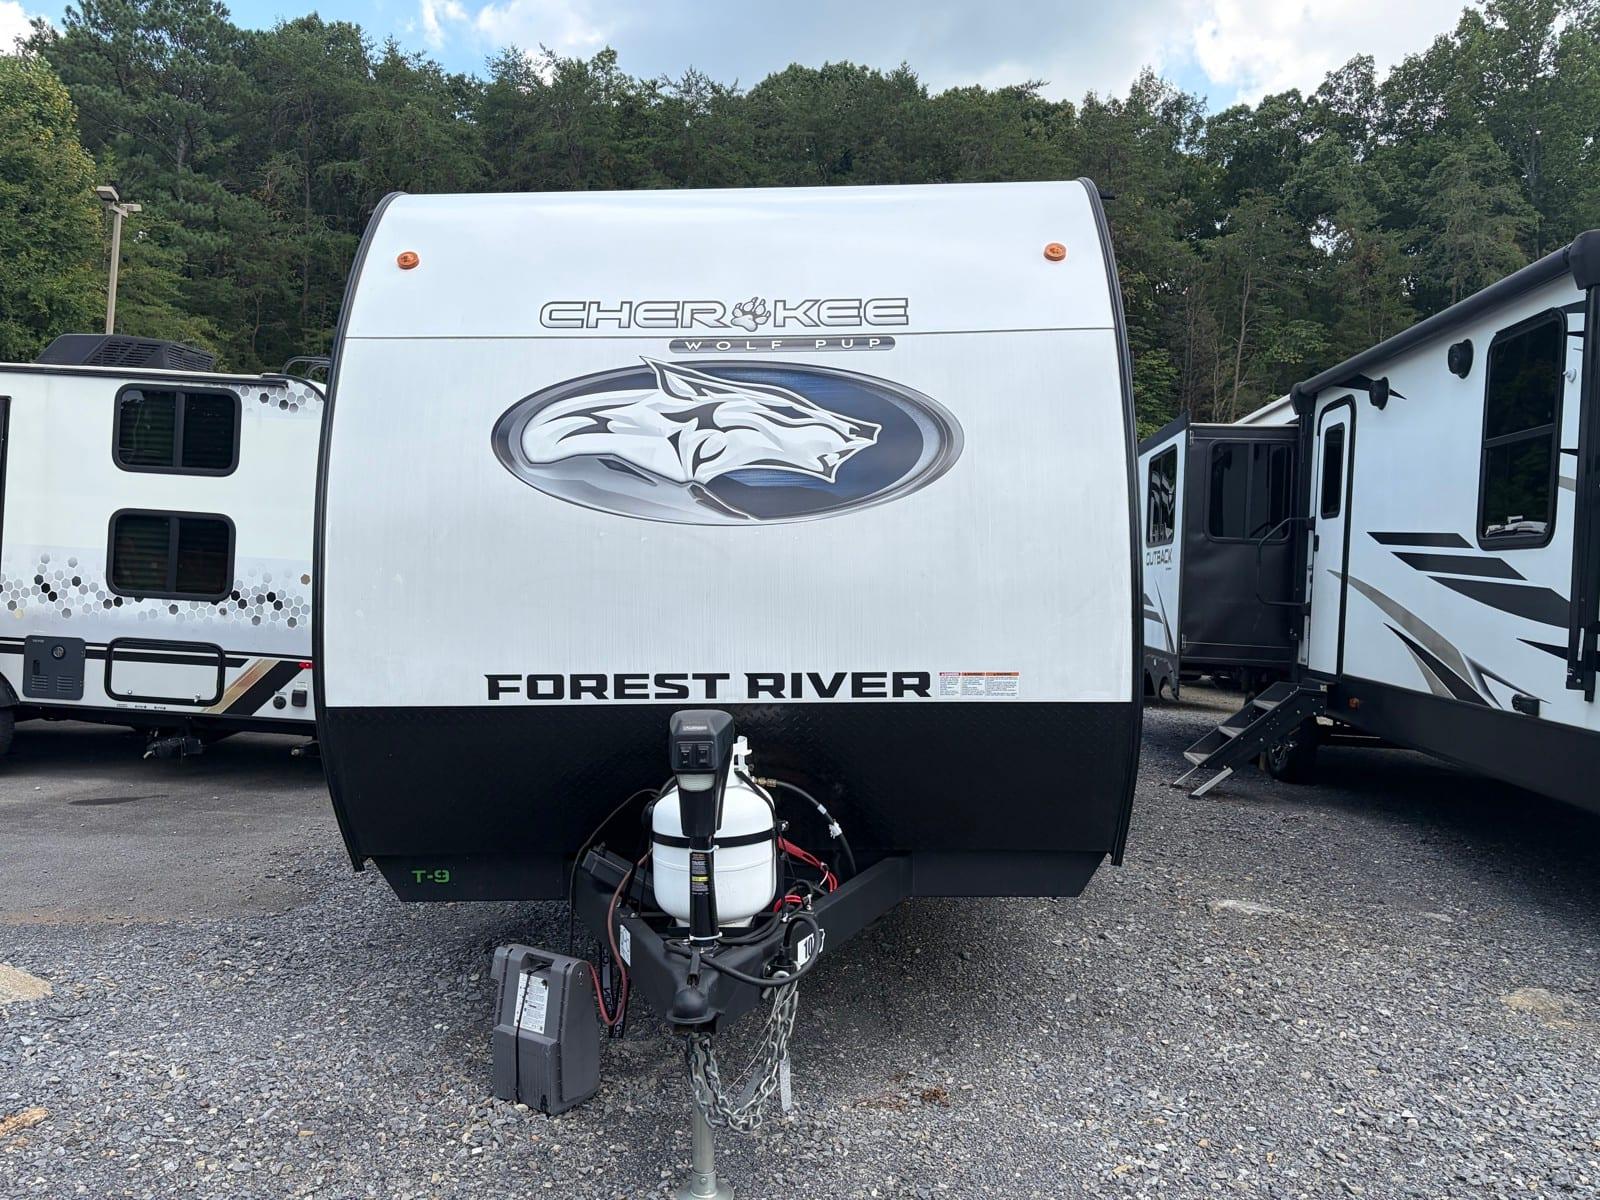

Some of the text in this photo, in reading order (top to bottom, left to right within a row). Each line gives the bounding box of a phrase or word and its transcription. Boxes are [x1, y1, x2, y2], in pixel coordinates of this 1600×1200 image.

[540, 297, 909, 332] CHERKEE
[686, 337, 882, 351] WOLF PUP
[484, 673, 731, 700] FOREST
[744, 671, 932, 699] RIVER
[411, 869, 450, 883] T-9
